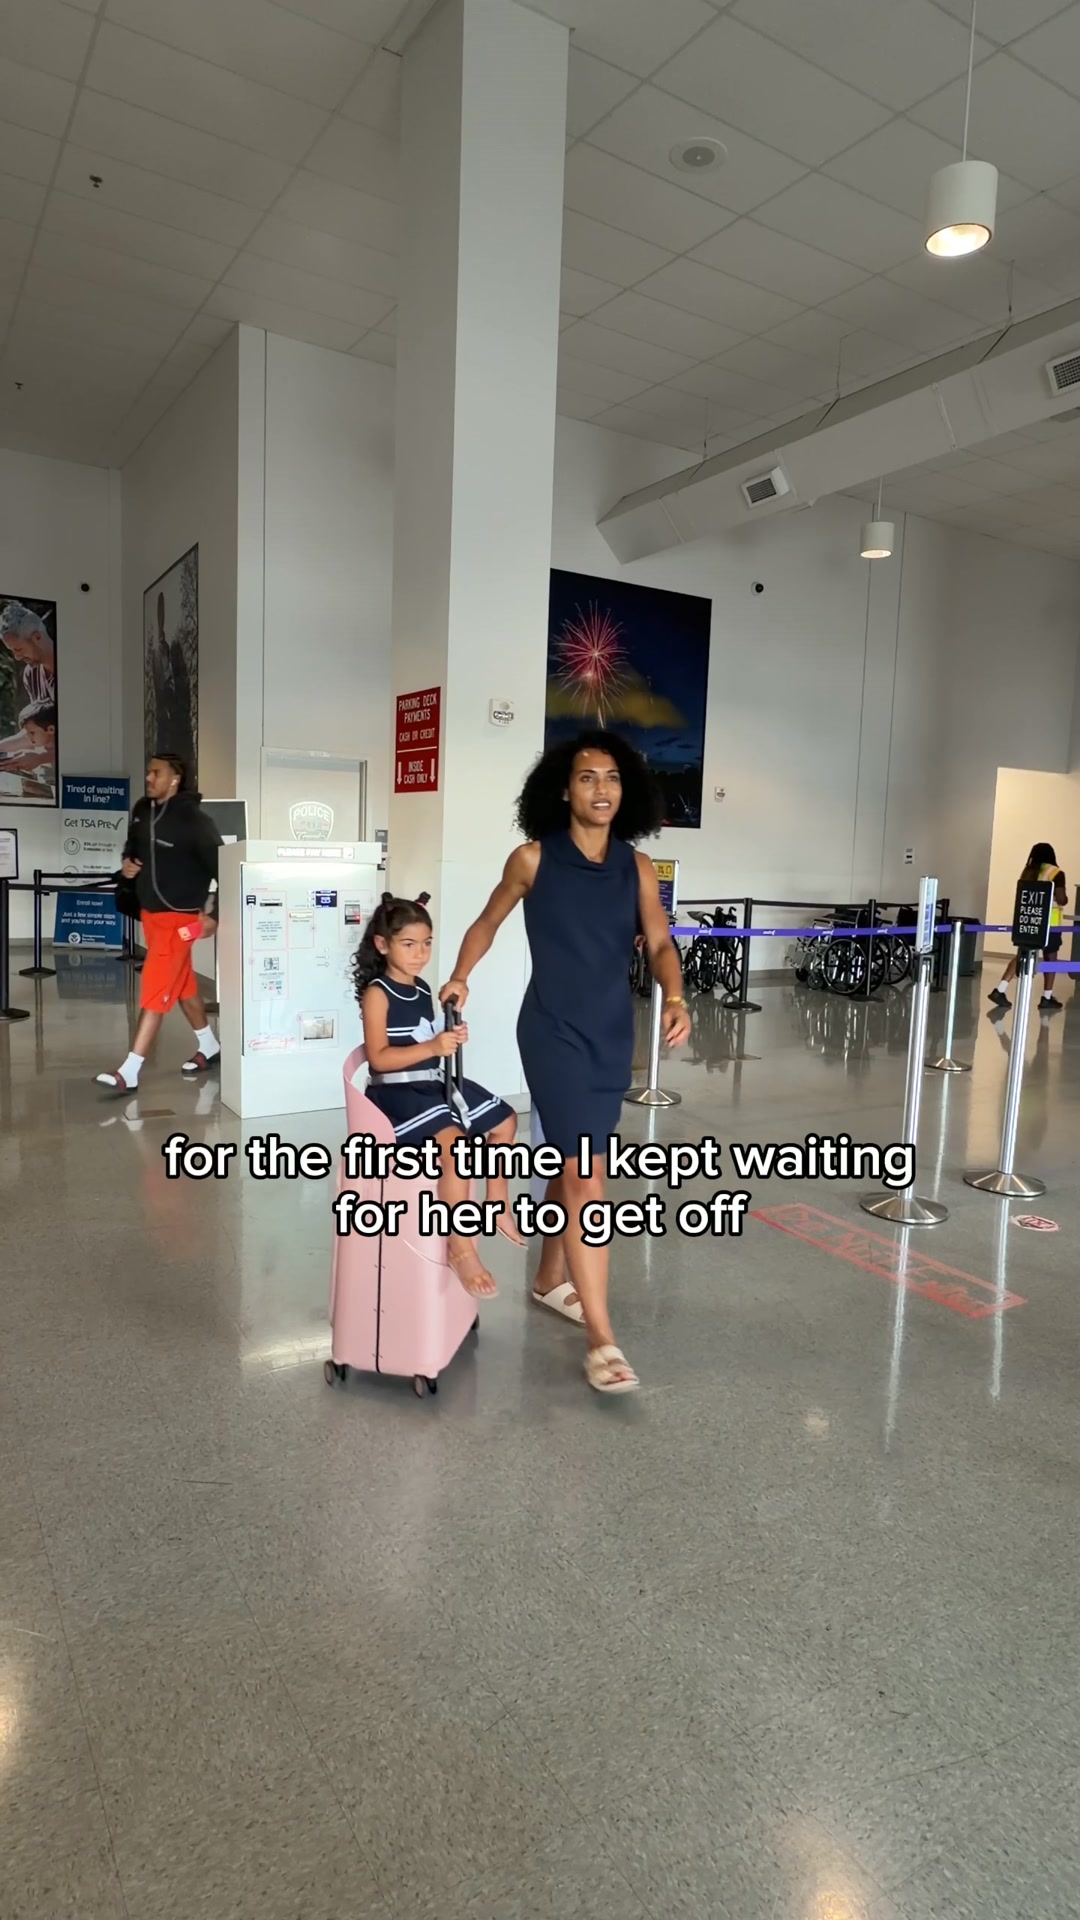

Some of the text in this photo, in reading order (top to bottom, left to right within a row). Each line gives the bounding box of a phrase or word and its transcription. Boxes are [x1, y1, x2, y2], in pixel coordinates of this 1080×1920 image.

[399, 693, 437, 711] PARKING DECK
[404, 709, 431, 724] PAYMENTS
[399, 731, 411, 742] CASH
[420, 727, 435, 739] CREDIT
[408, 760, 424, 772] INSIDE
[416, 773, 428, 783] ONLY
[67, 785, 125, 796] Tired of waiting
[92, 795, 110, 803] line?
[293, 806, 331, 821] POLICE
[64, 818, 79, 828] Get
[80, 819, 97, 829] TSA
[1021, 890, 1045, 905] EXIT
[1020, 906, 1043, 916] PLEASE
[1019, 915, 1042, 925] DO NOT
[1019, 925, 1039, 935] ENTER
